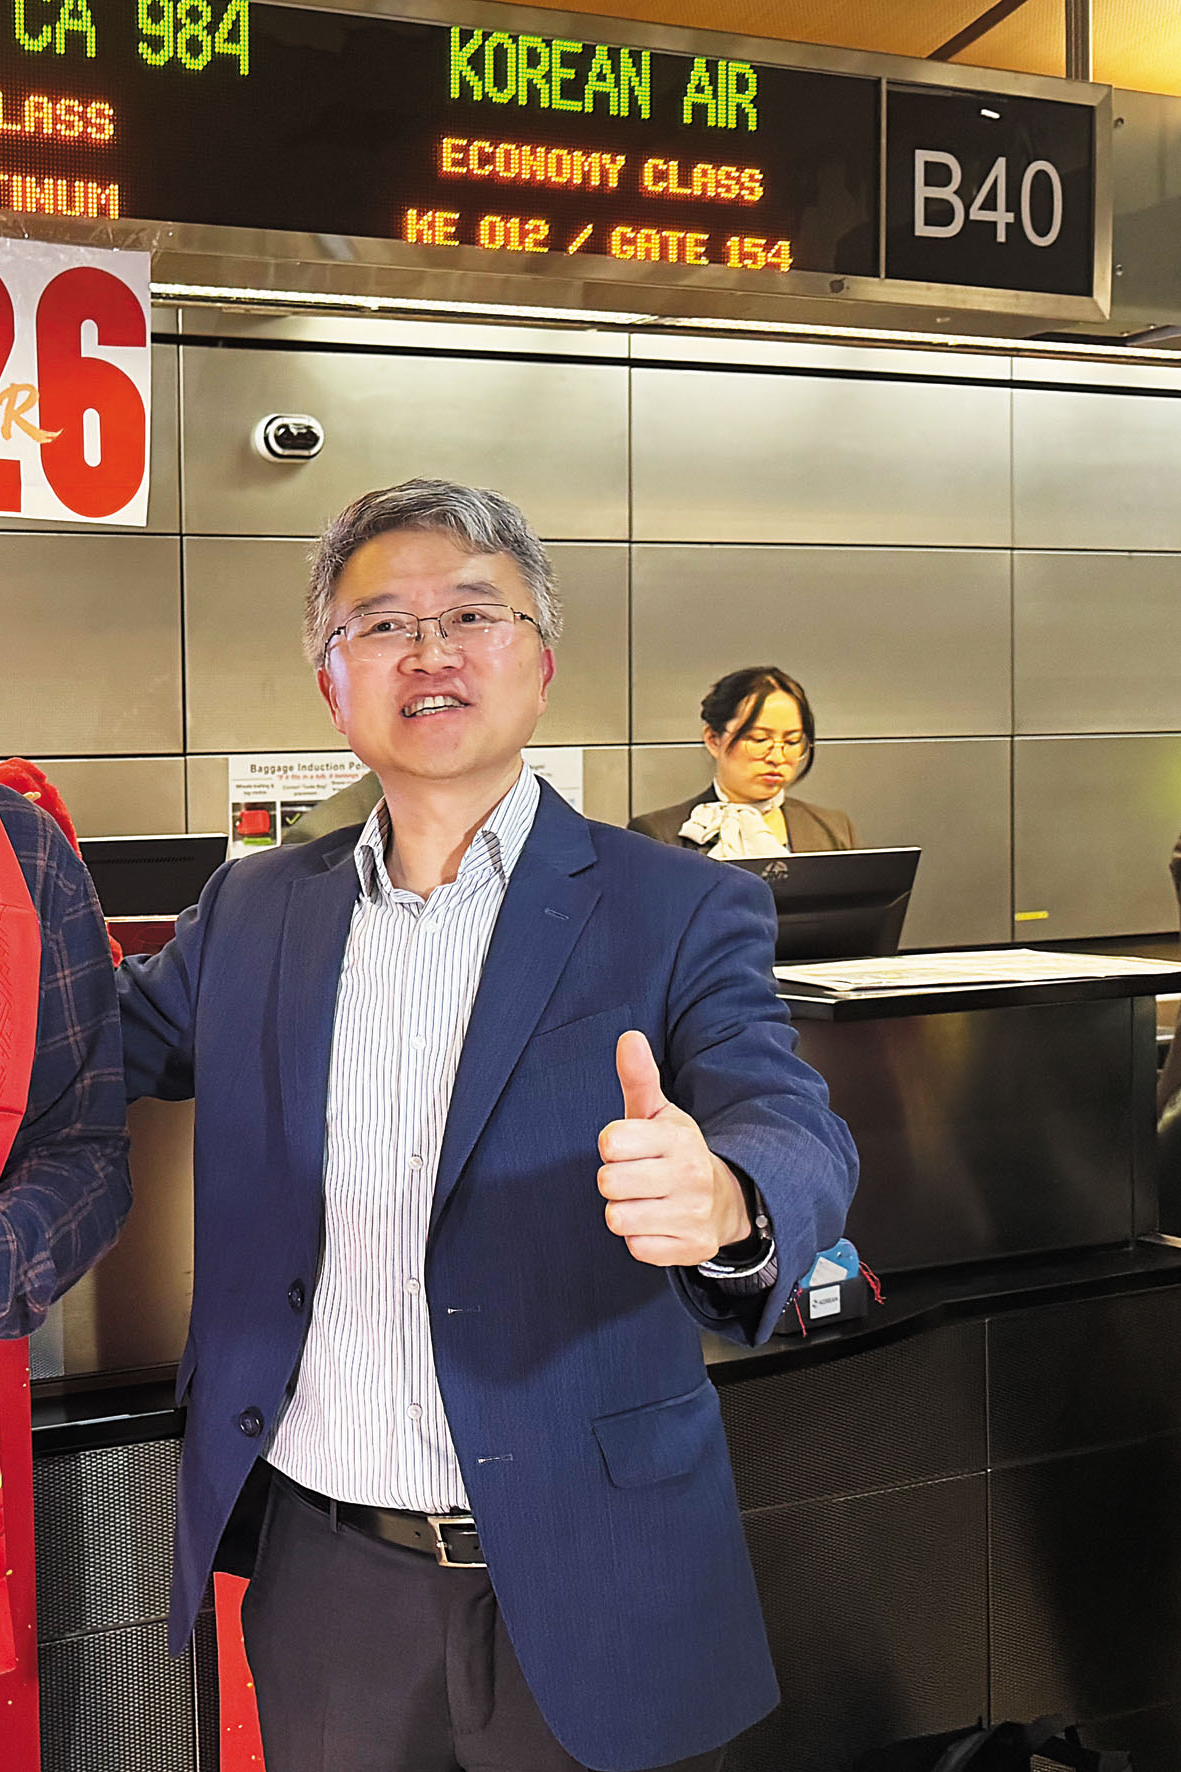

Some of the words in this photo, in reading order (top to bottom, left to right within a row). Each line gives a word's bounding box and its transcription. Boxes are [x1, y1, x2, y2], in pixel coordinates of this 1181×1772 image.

[137, 0, 250, 76] 984
[450, 26, 651, 119] KOREAN
[682, 57, 758, 132] AIR
[441, 137, 626, 188] ECONOMY
[642, 158, 765, 201] CLASS
[914, 149, 1063, 247] B40
[406, 209, 460, 246] KE
[478, 215, 551, 253] 012
[567, 223, 594, 255] /
[610, 226, 710, 265] GATE
[725, 236, 794, 273] 154
[250, 764, 294, 775] Baggage
[297, 763, 346, 772] Induction
